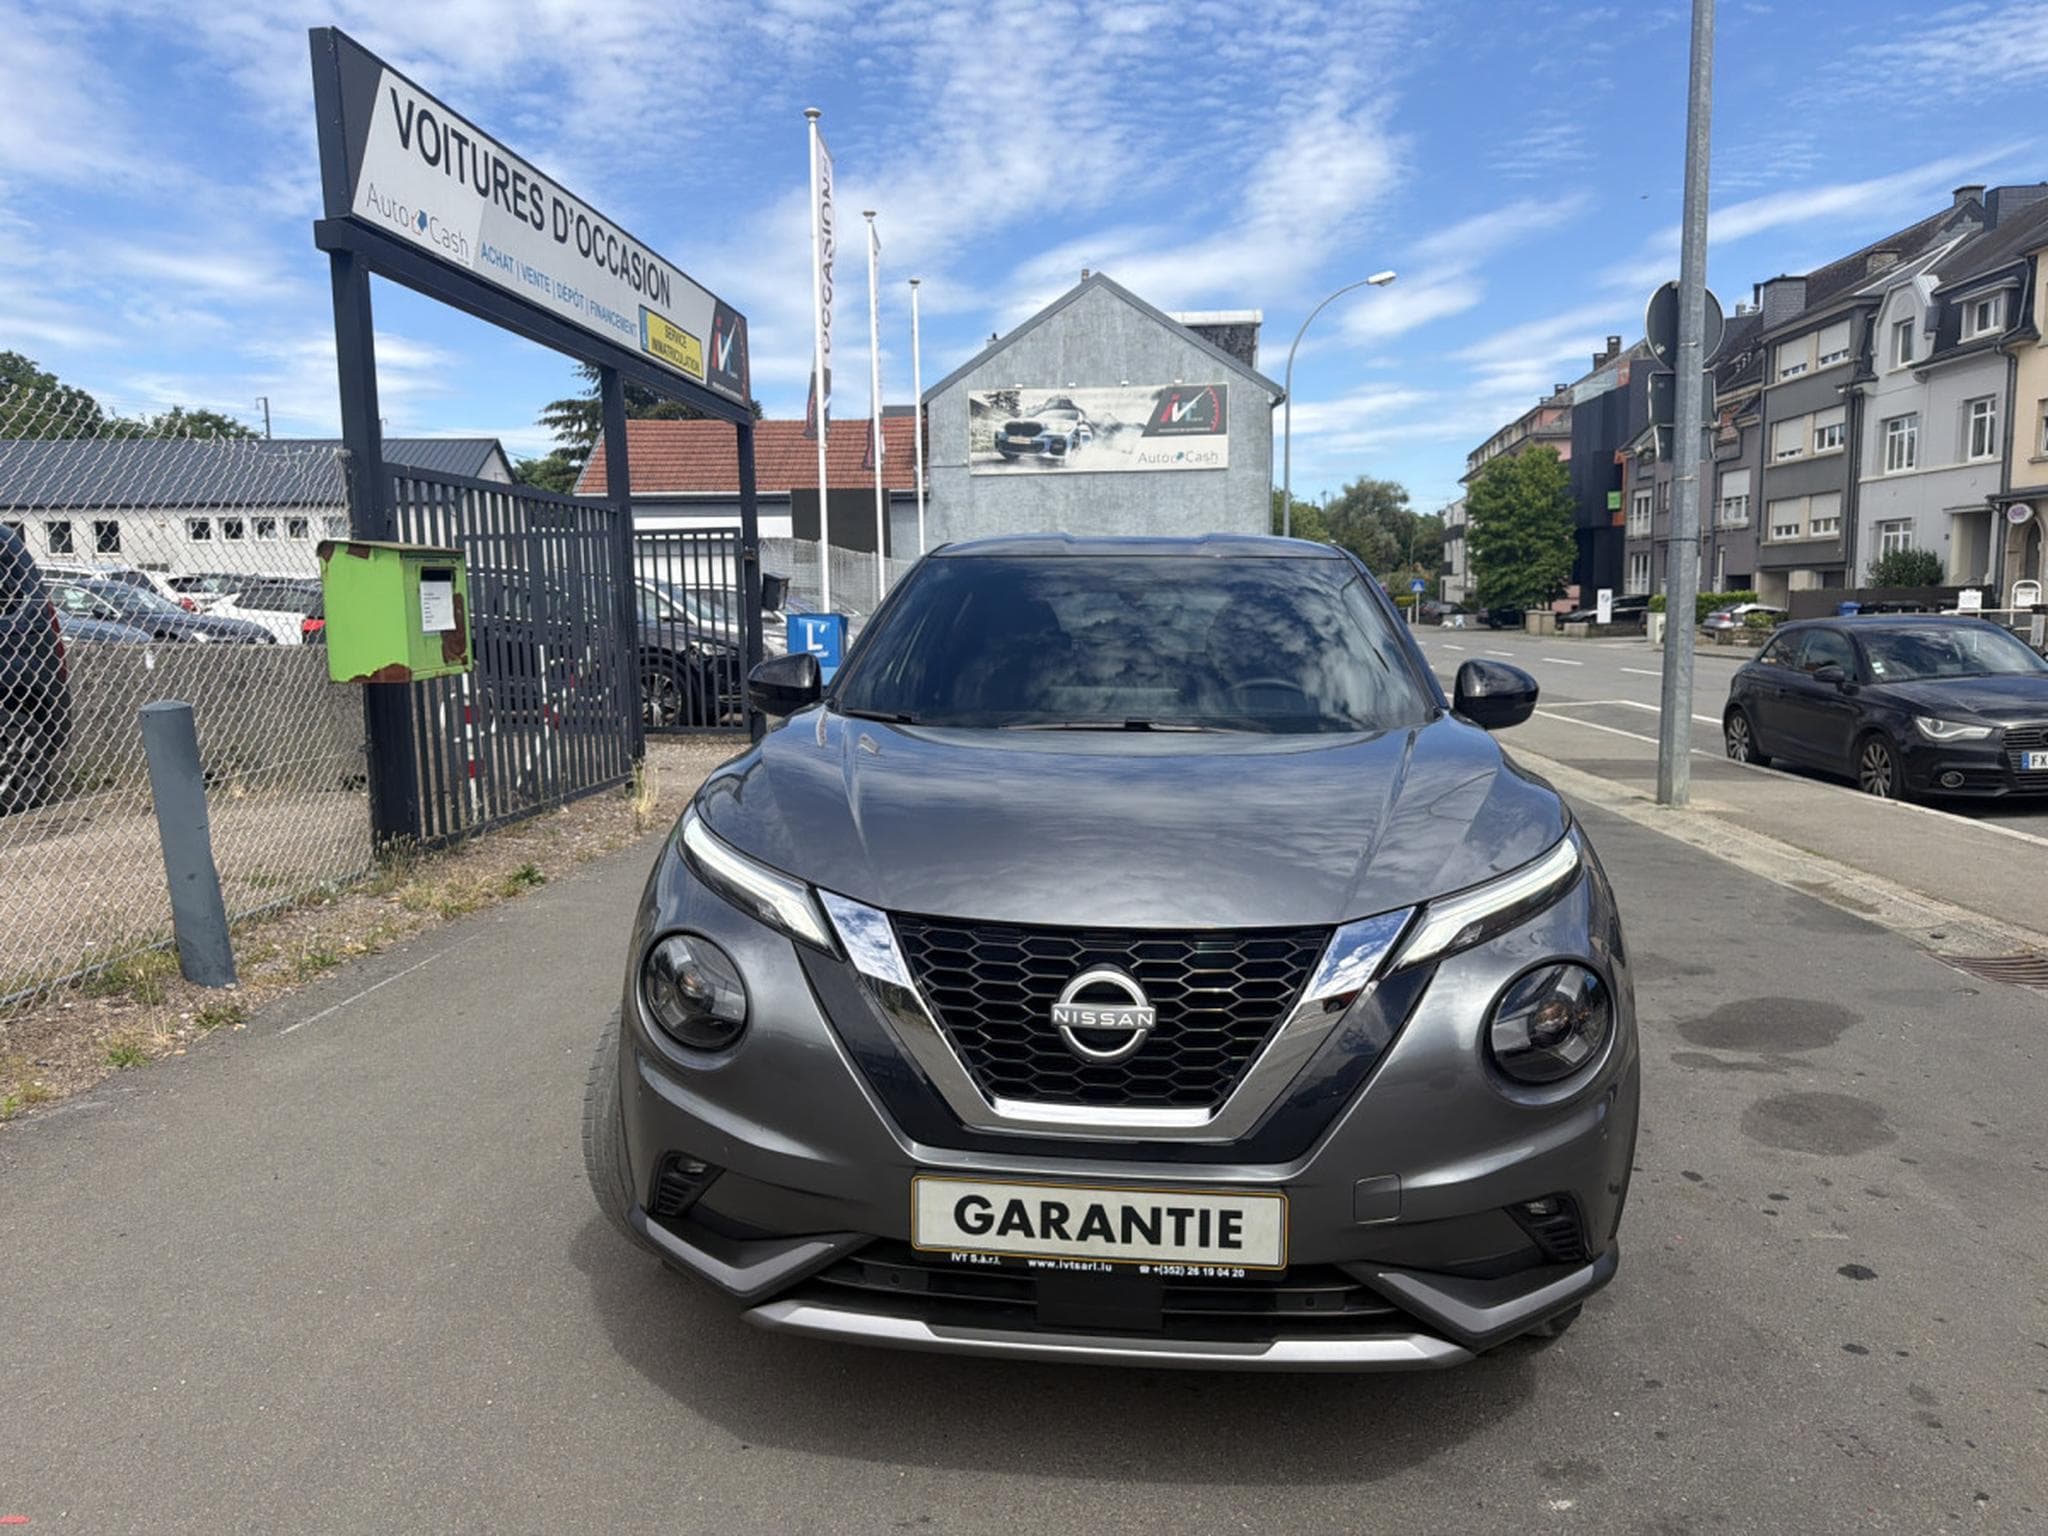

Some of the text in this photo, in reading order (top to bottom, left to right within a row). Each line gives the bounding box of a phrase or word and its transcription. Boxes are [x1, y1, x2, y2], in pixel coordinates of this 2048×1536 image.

[366, 182, 469, 258] Auto Cash
[389, 86, 671, 308] VOITURES D'OCCASION
[480, 241, 514, 273] ACHAT
[521, 263, 551, 294] VENTE
[590, 300, 638, 338] FINANCEMENT
[1186, 451, 1218, 464] Cash
[1053, 1008, 1153, 1026] NISSAN
[953, 1194, 1243, 1249] GARANTIE
[1203, 1267, 1215, 1277] 19
[1216, 1268, 1230, 1277] 04
[1231, 1269, 1245, 1278] 20
